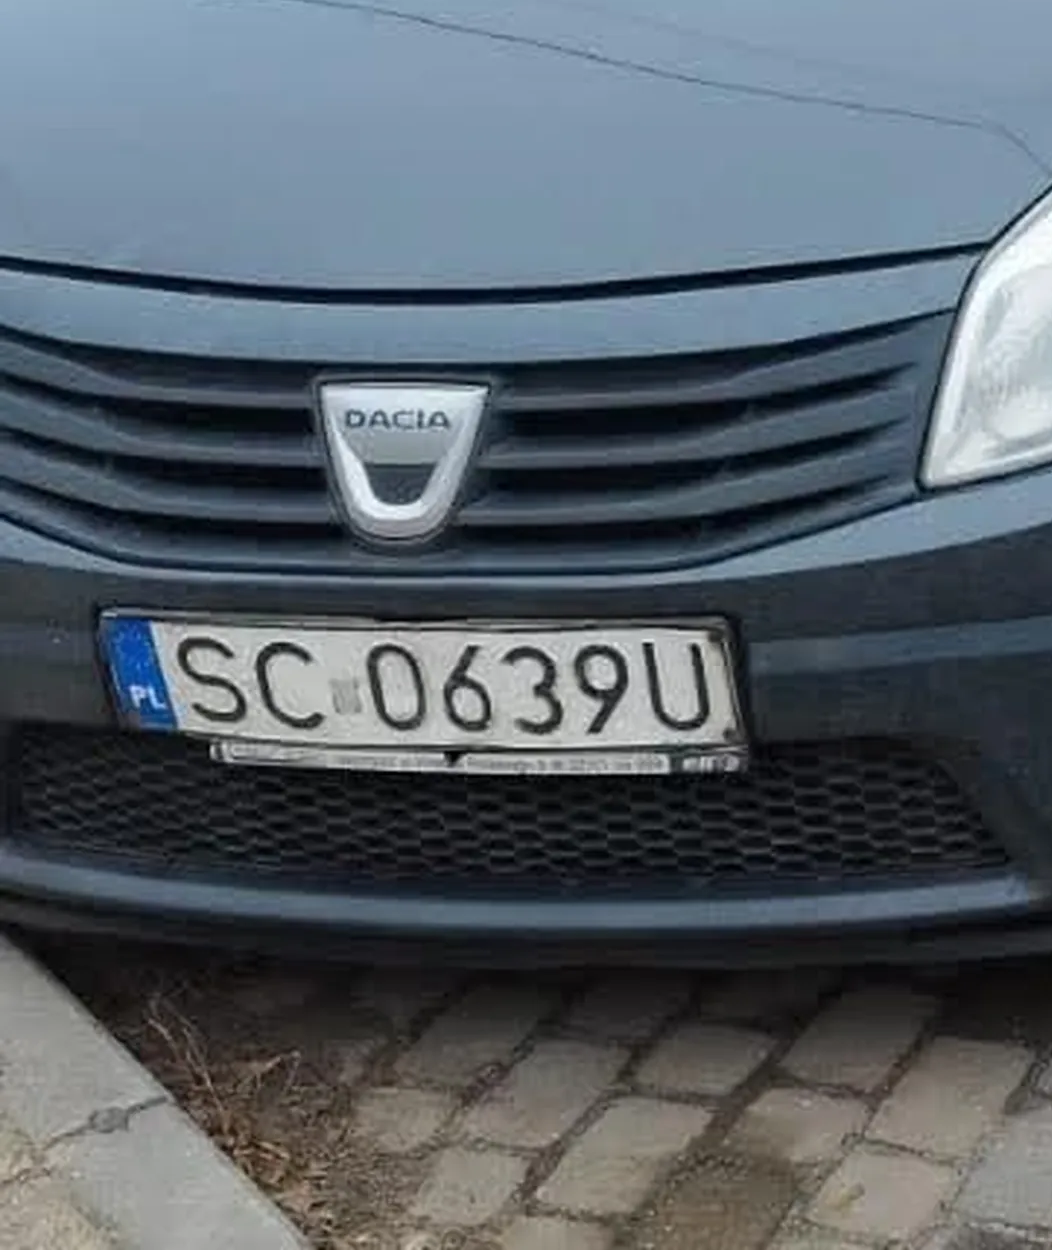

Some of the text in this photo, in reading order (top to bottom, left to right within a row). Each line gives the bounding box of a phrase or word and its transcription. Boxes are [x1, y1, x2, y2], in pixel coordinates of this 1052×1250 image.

[345, 408, 451, 430] DACIA
[129, 684, 168, 709] PL
[177, 636, 711, 736] SC 0639U
